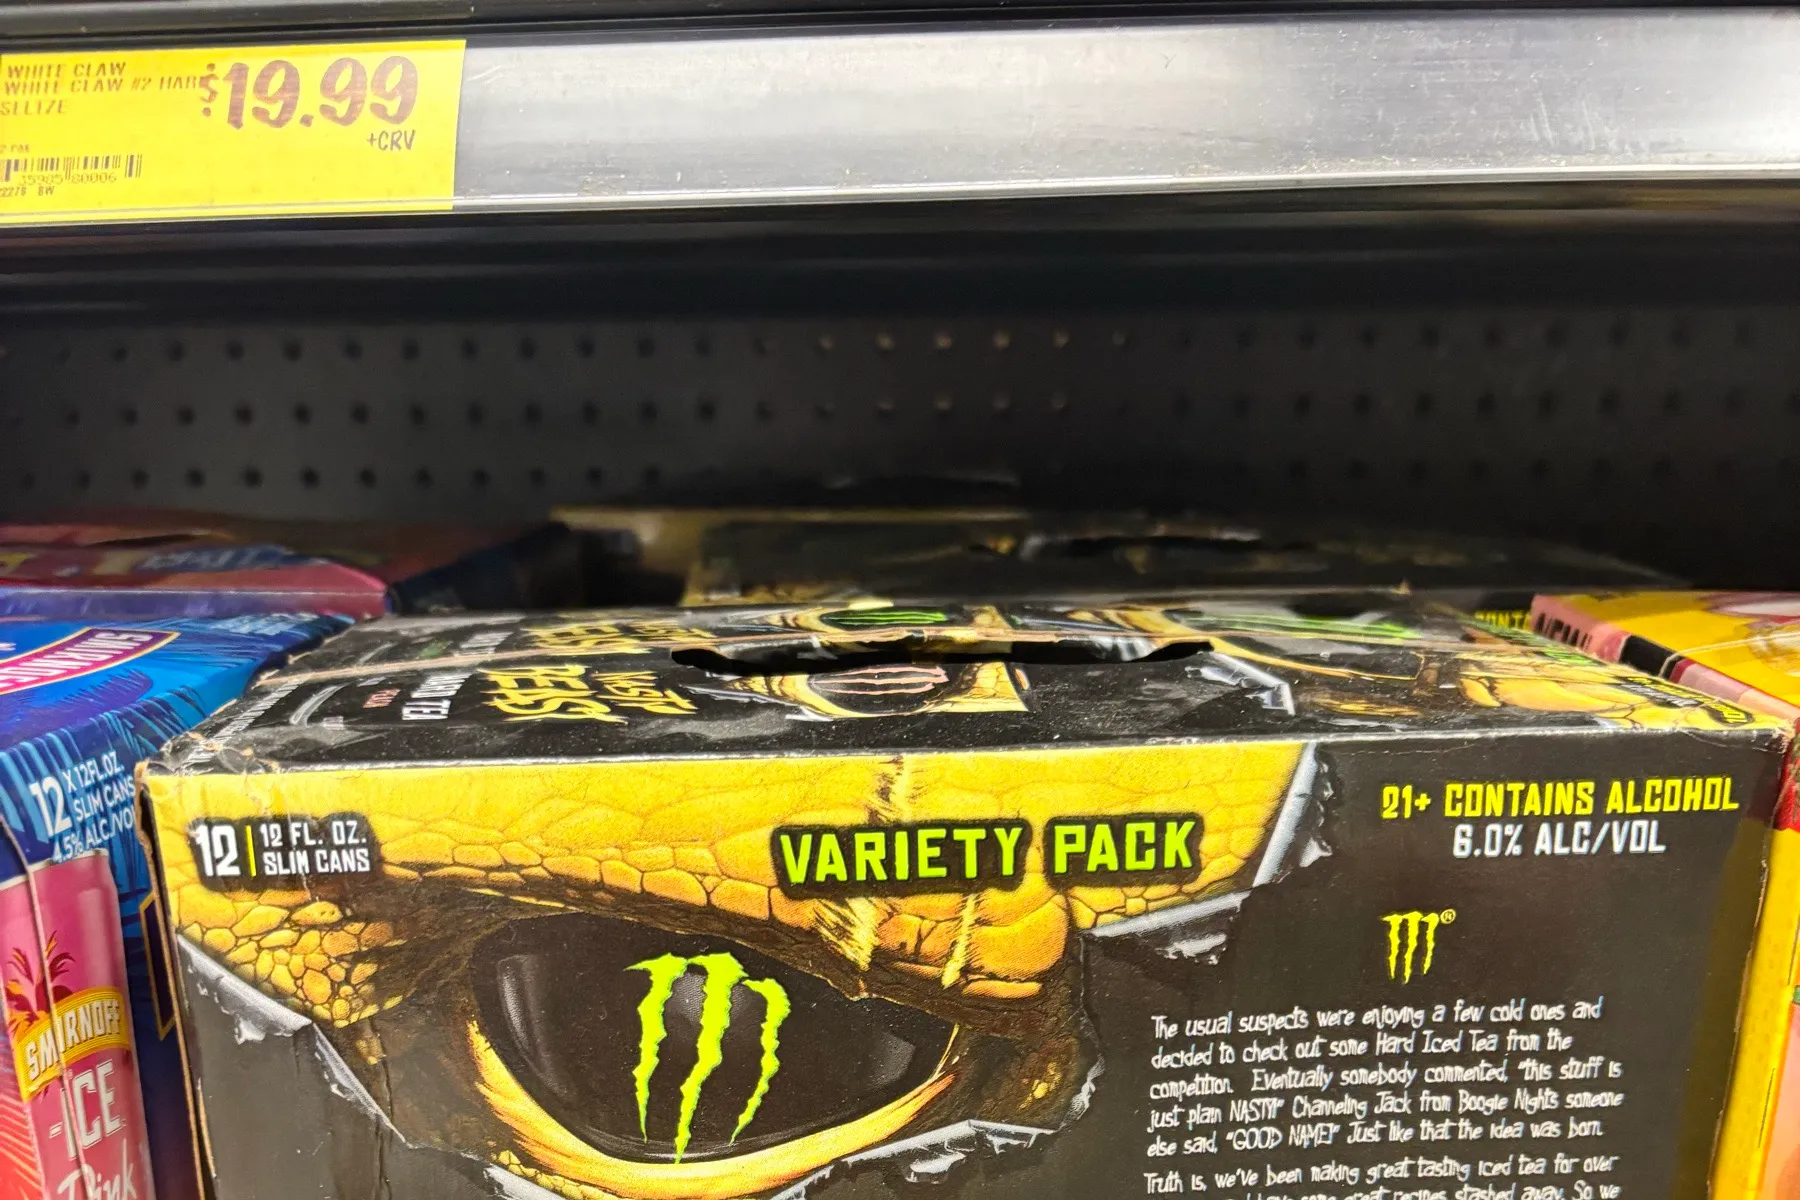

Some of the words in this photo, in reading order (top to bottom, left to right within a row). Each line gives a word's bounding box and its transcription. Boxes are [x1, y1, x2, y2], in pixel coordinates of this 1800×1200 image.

[71, 78, 124, 92] CLAW
[73, 62, 126, 77] CLAW
[200, 55, 418, 130] $19.99
[367, 129, 417, 152] +CRV
[29, 776, 72, 837] 12
[73, 788, 104, 822] SLIM
[102, 775, 136, 807] CANS
[1382, 785, 1431, 820] 21+
[1445, 782, 1595, 817] CONTAINS
[1606, 777, 1739, 815] ALCOHOL
[196, 824, 241, 877] 12
[260, 823, 282, 848] 12
[290, 822, 324, 848] FL.
[332, 821, 367, 845] OZ.
[778, 825, 1023, 885] VARIETY
[1052, 820, 1196, 874] PACK
[1453, 823, 1523, 858] 6.0%
[1534, 820, 1666, 856] ALC/VOL
[263, 850, 310, 876] SLIM
[315, 848, 371, 874] CANS
[1151, 1015, 1178, 1039] The
[1185, 1011, 1232, 1036] usual
[1238, 1006, 1309, 1035] suspects
[1316, 1009, 1355, 1027] were
[1362, 1005, 1424, 1028] enjoying
[1432, 1004, 1446, 1022] a
[1453, 999, 1485, 1023] few
[1490, 998, 1526, 1022] cold
[1530, 1004, 1565, 1020] ones
[1572, 995, 1604, 1020] and
[26, 999, 123, 1081] SMIRNOFF
[1151, 1043, 1214, 1069] decided
[1219, 1042, 1235, 1065] to
[1243, 1038, 1288, 1063] check
[1295, 1035, 1327, 1058] out
[1329, 1040, 1368, 1057] some
[1375, 1031, 1416, 1053] Hard
[1422, 1030, 1463, 1053] Iced
[1469, 1030, 1498, 1052] Tea
[1507, 1028, 1540, 1051] from
[1547, 1027, 1573, 1051] the
